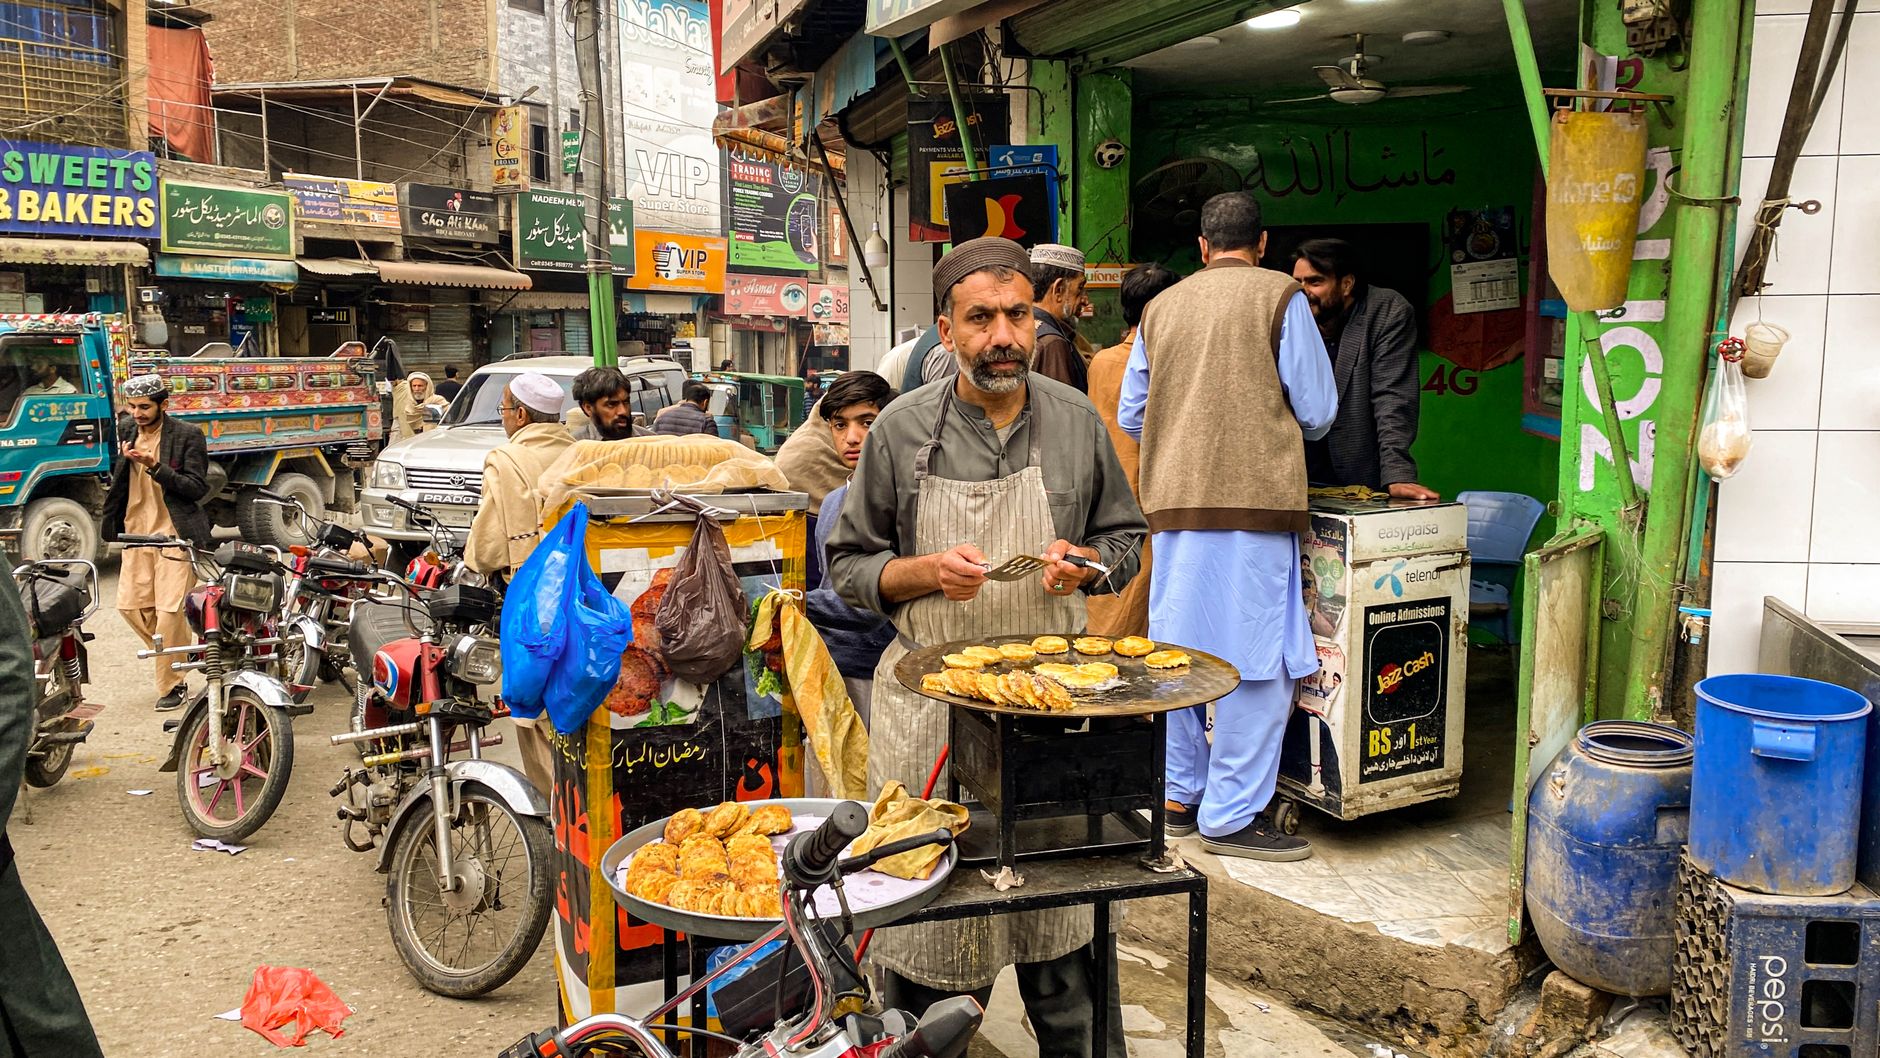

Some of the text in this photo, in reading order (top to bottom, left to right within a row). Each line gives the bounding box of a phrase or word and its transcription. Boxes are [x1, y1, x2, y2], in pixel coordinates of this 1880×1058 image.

[933, 121, 956, 138] Jazz
[499, 143, 516, 153] SAK
[2, 150, 152, 191] SWEETS
[495, 158, 518, 166] BROAST
[733, 163, 771, 177] TRADING
[636, 150, 710, 199] VIP
[17, 189, 156, 227] BAKERS
[531, 194, 565, 205] NADEEM
[565, 198, 585, 208] MEDI
[638, 197, 710, 215] Super Store
[447, 215, 462, 229] Ali
[464, 216, 489, 232] Khan
[526, 217, 550, 241] سٹور
[678, 248, 707, 269] VIP
[1421, 363, 1479, 396] 4G
[17, 438, 38, 446] 200
[423, 493, 474, 505] PRADO
[1378, 523, 1440, 541] easypaisa
[1369, 604, 1446, 626] Online Admissions
[1376, 651, 1435, 695] Jazz Cash
[1368, 727, 1392, 758] BS
[1393, 734, 1407, 750] اور
[1423, 735, 1437, 745] Year
[654, 741, 710, 769] رمضان
[1747, 985, 1755, 1023] BEVERAGES
[1756, 955, 1788, 1043] pepsi
